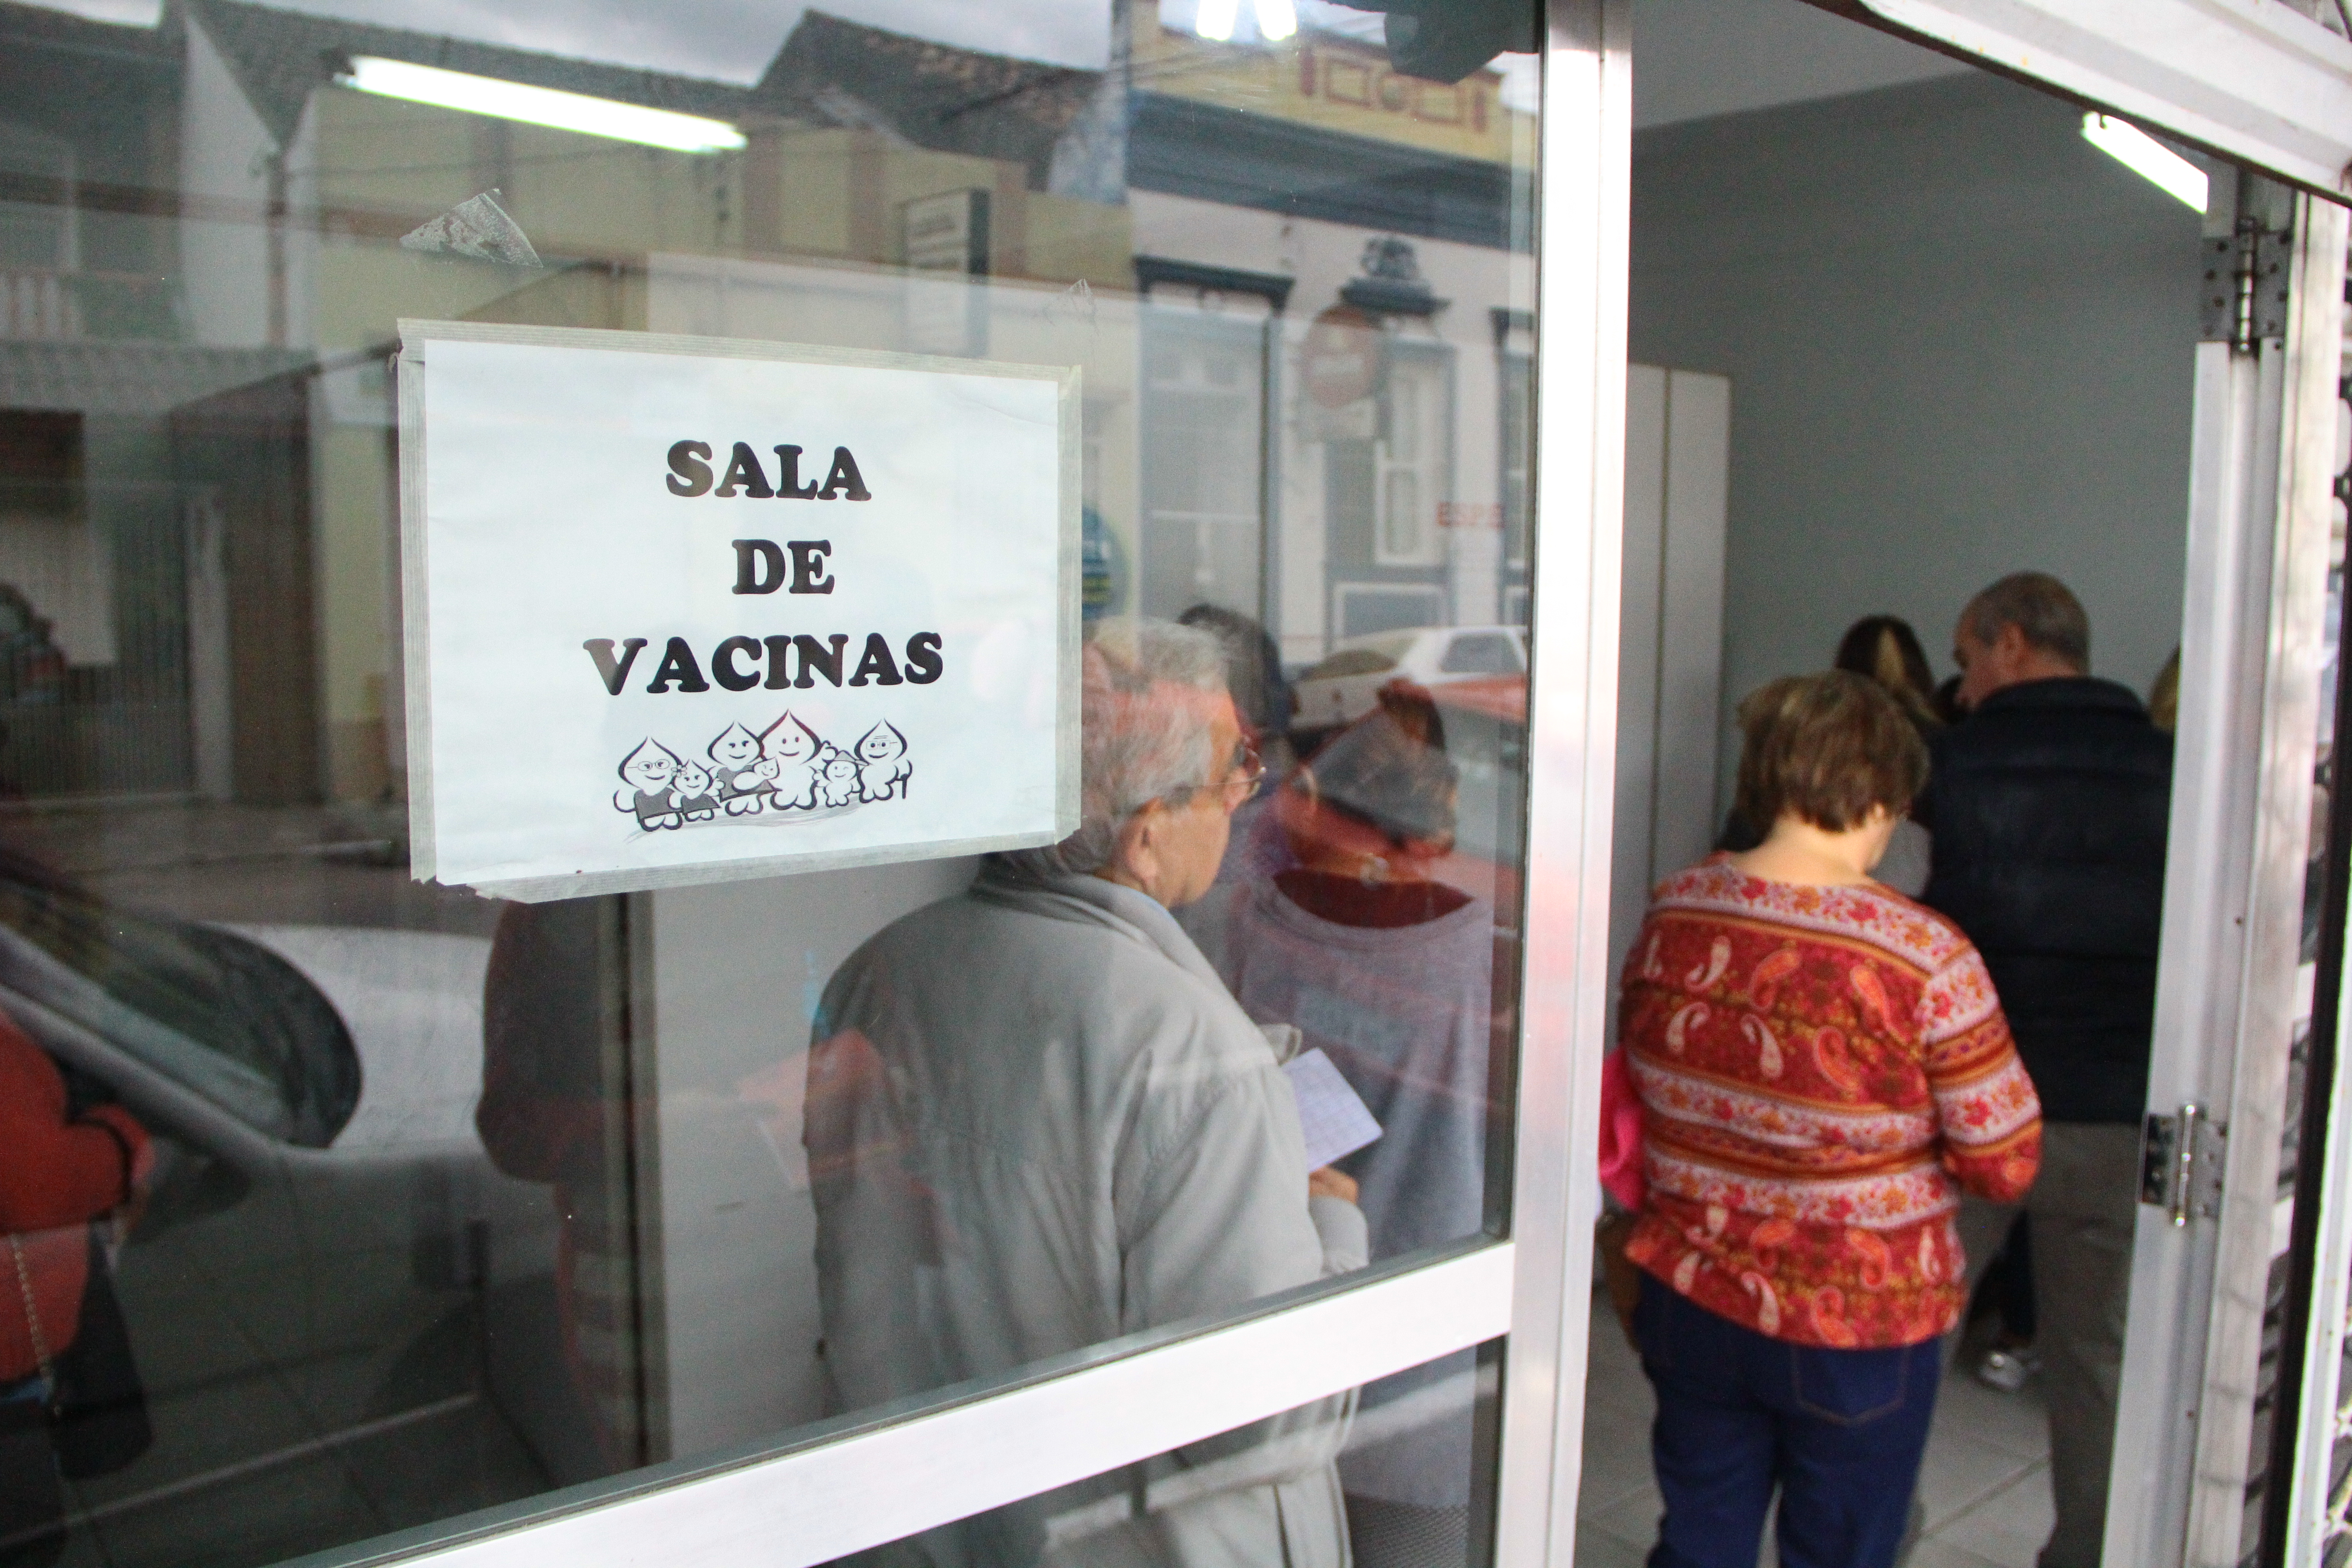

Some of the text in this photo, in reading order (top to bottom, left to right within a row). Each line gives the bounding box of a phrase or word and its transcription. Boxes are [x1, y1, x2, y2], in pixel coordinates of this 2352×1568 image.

[666, 440, 871, 501] SALA
[732, 539, 834, 594] DE
[583, 632, 943, 696] VACINAS
